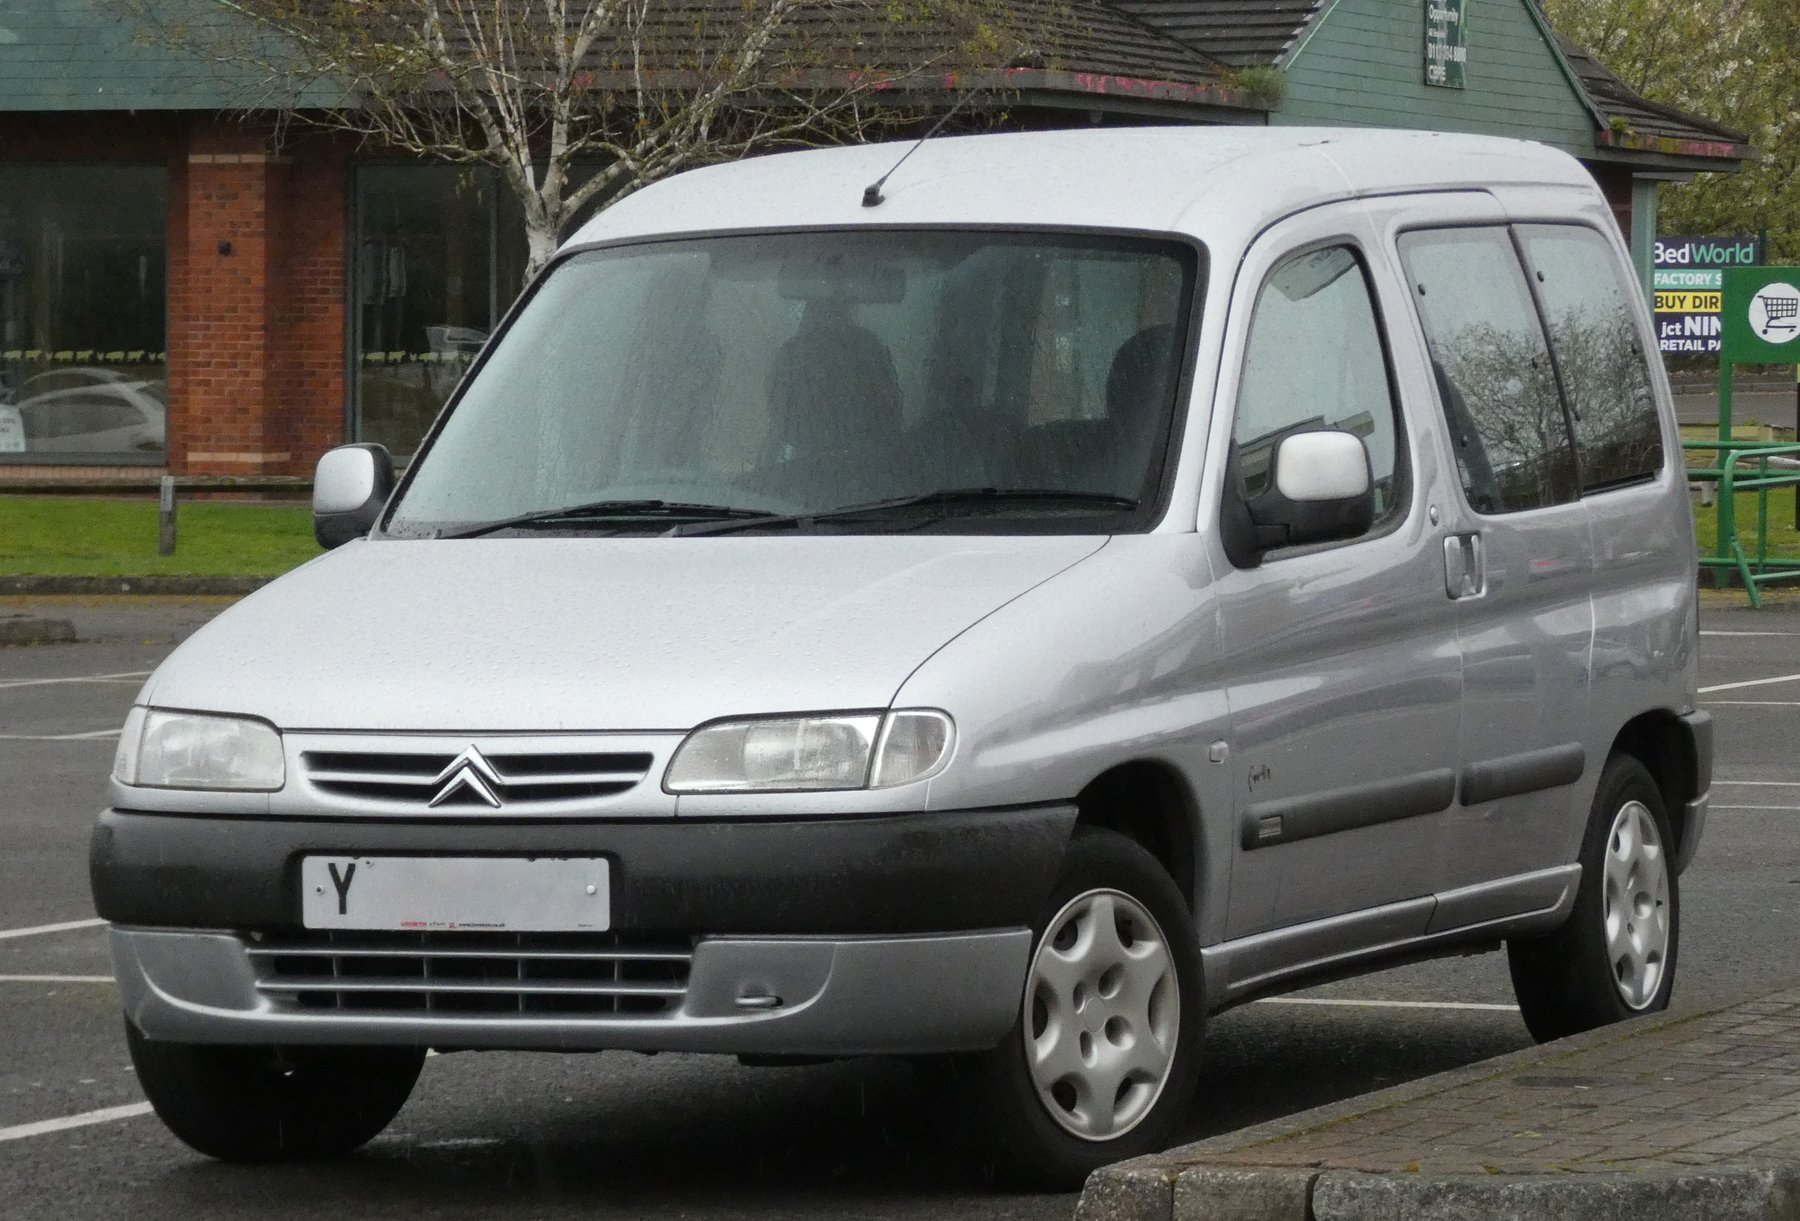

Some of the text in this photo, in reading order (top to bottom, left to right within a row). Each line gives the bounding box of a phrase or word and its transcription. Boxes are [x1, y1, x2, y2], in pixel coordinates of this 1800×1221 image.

[1655, 273, 1712, 285] FACTORY
[1655, 295, 1687, 309] BUY
[1661, 321, 1682, 338] jct
[1660, 339, 1706, 351] RETAIL
[328, 862, 356, 915] Y
